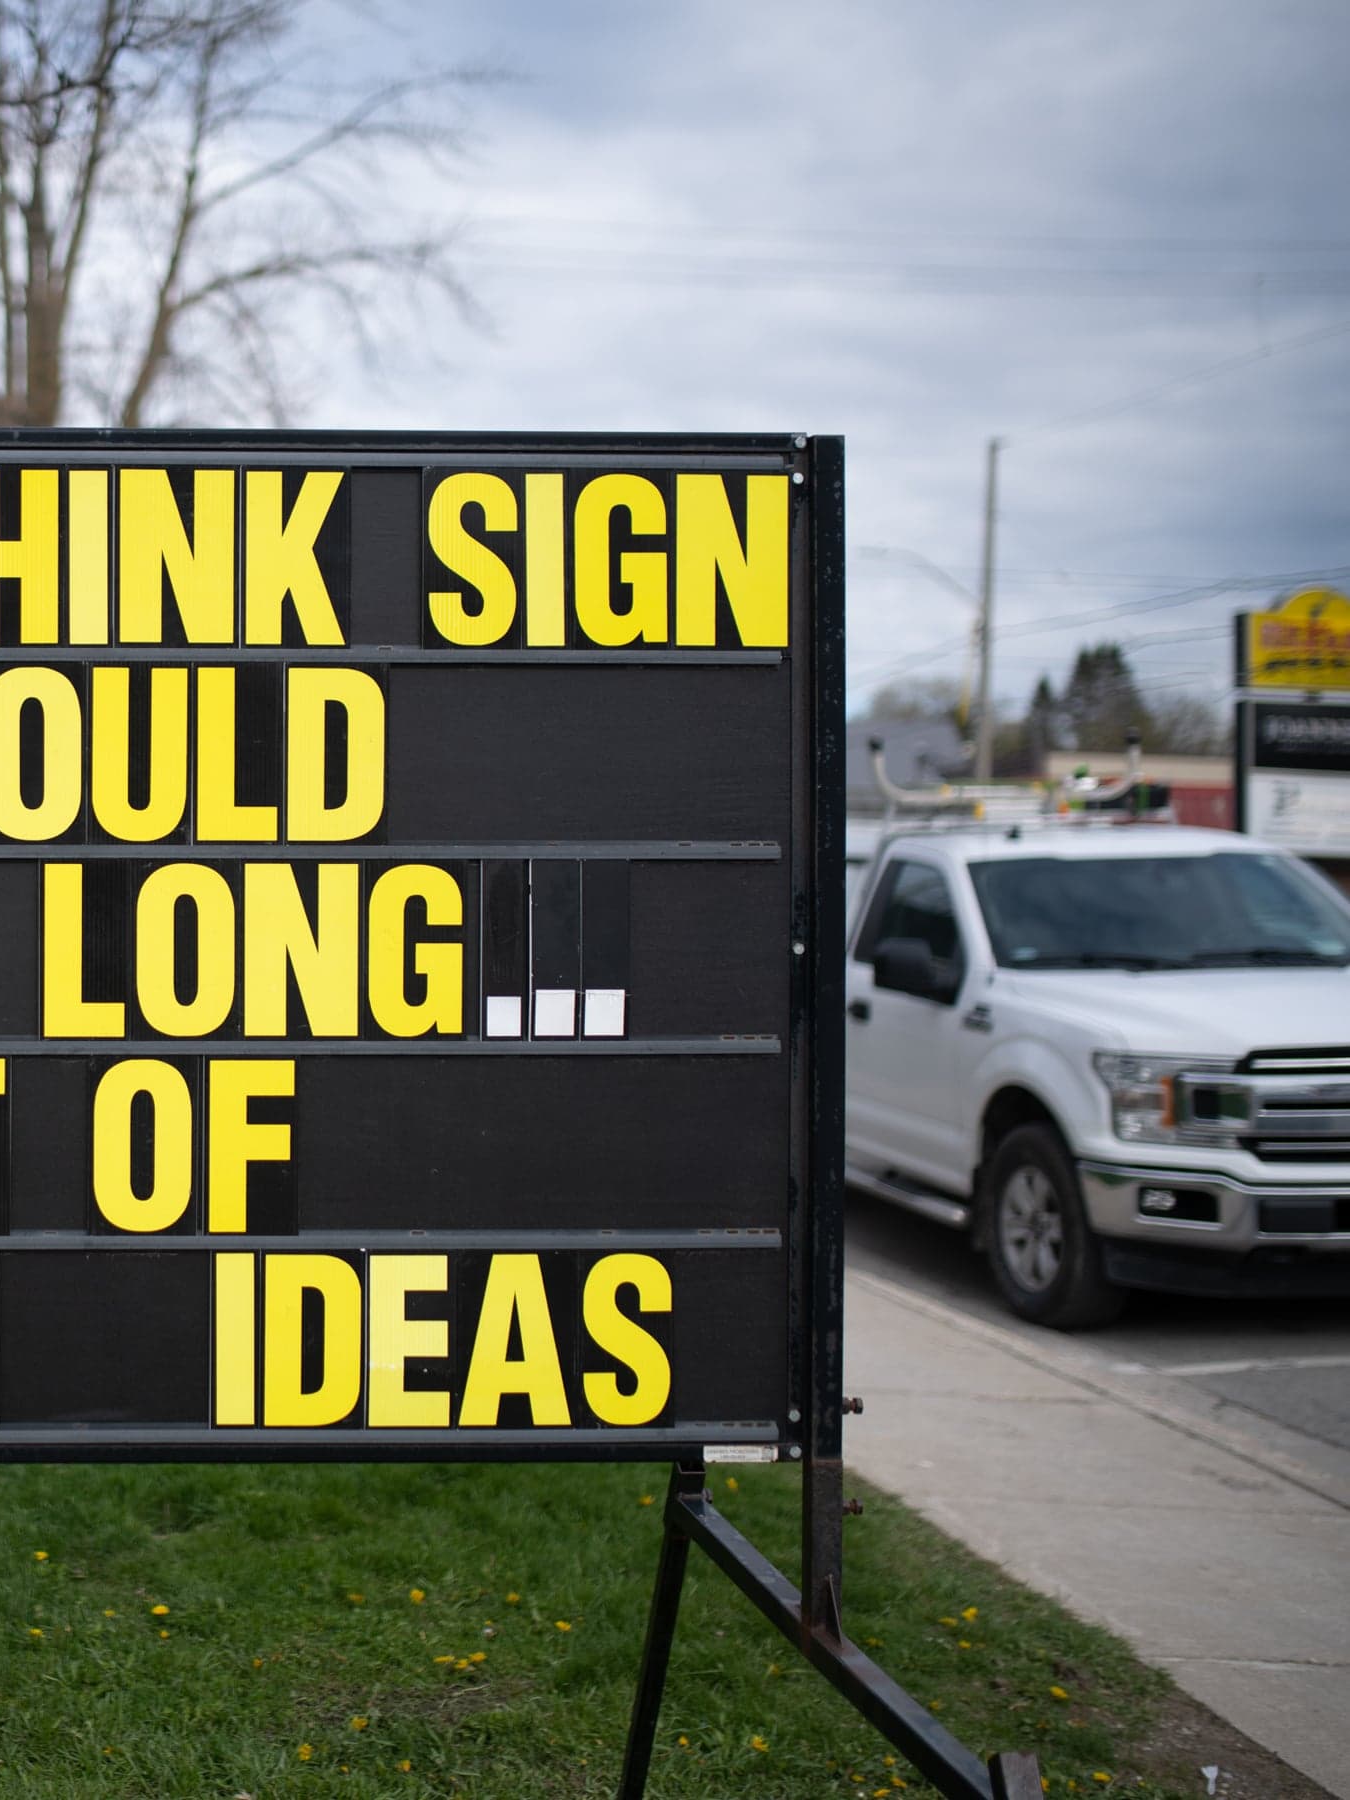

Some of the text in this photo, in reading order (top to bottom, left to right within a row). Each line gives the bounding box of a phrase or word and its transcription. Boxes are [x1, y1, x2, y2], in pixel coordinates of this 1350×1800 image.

[429, 473, 788, 647] SIGN
[44, 863, 625, 1037] LONG...
[94, 1059, 295, 1232] OF
[216, 1253, 672, 1426] IDEAS
